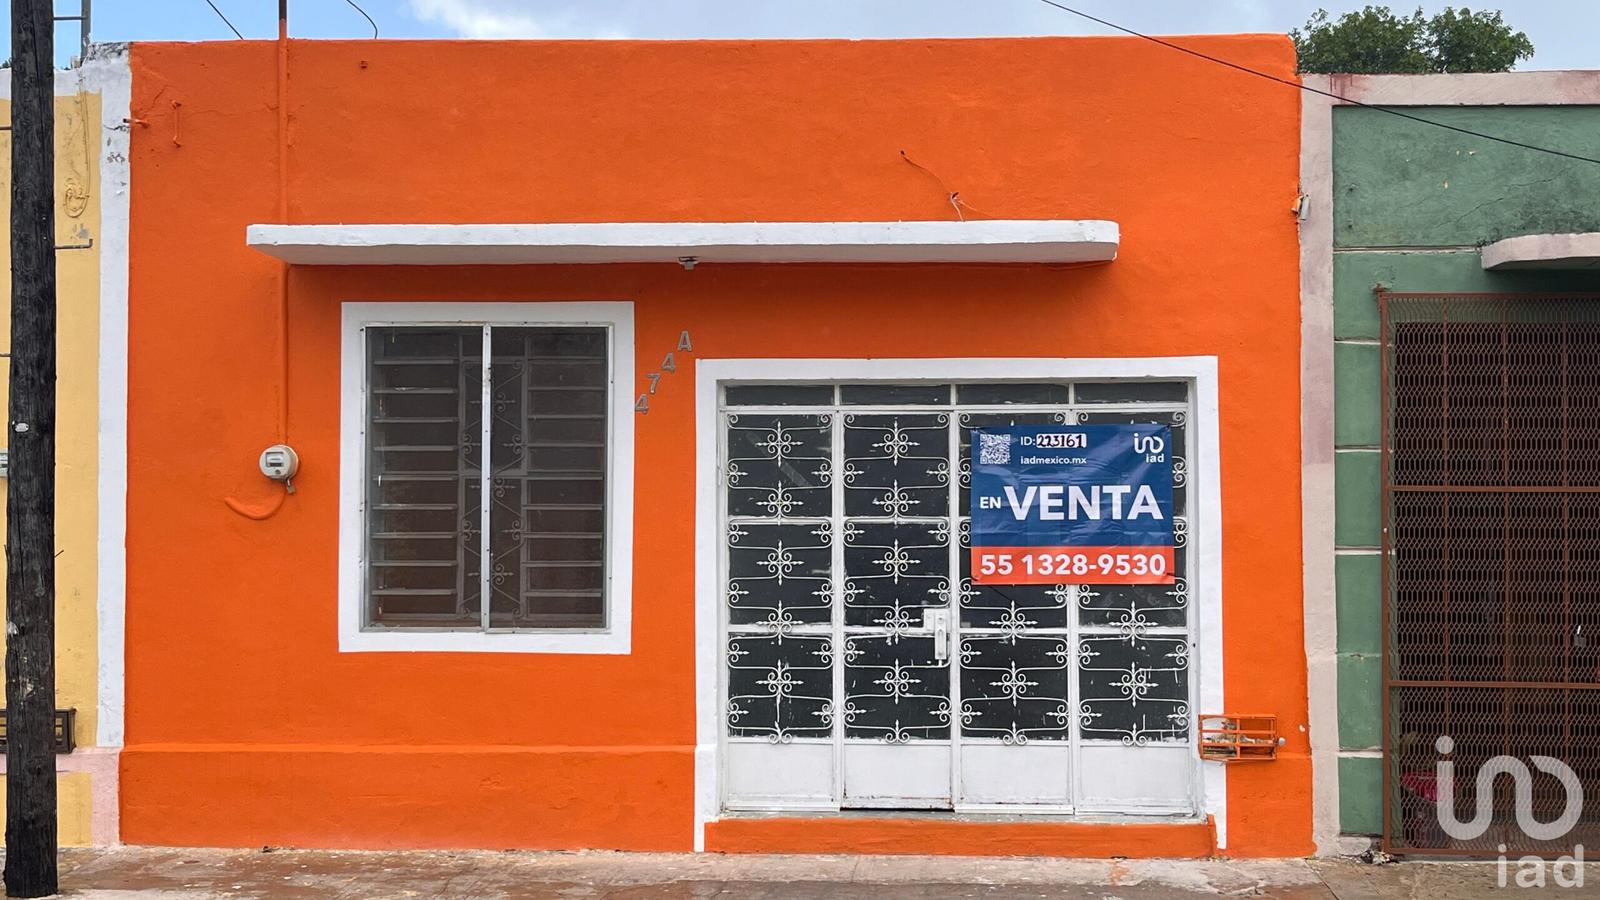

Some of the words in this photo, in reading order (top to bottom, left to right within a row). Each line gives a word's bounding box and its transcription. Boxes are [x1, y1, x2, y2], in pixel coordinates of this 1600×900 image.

[1020, 455, 1087, 465] iadmexico.mx
[1145, 453, 1165, 463] iad
[980, 497, 1001, 509] EN
[1003, 485, 1164, 521] VENTA
[980, 554, 1013, 575] 55
[1021, 554, 1166, 576] 1328-9530
